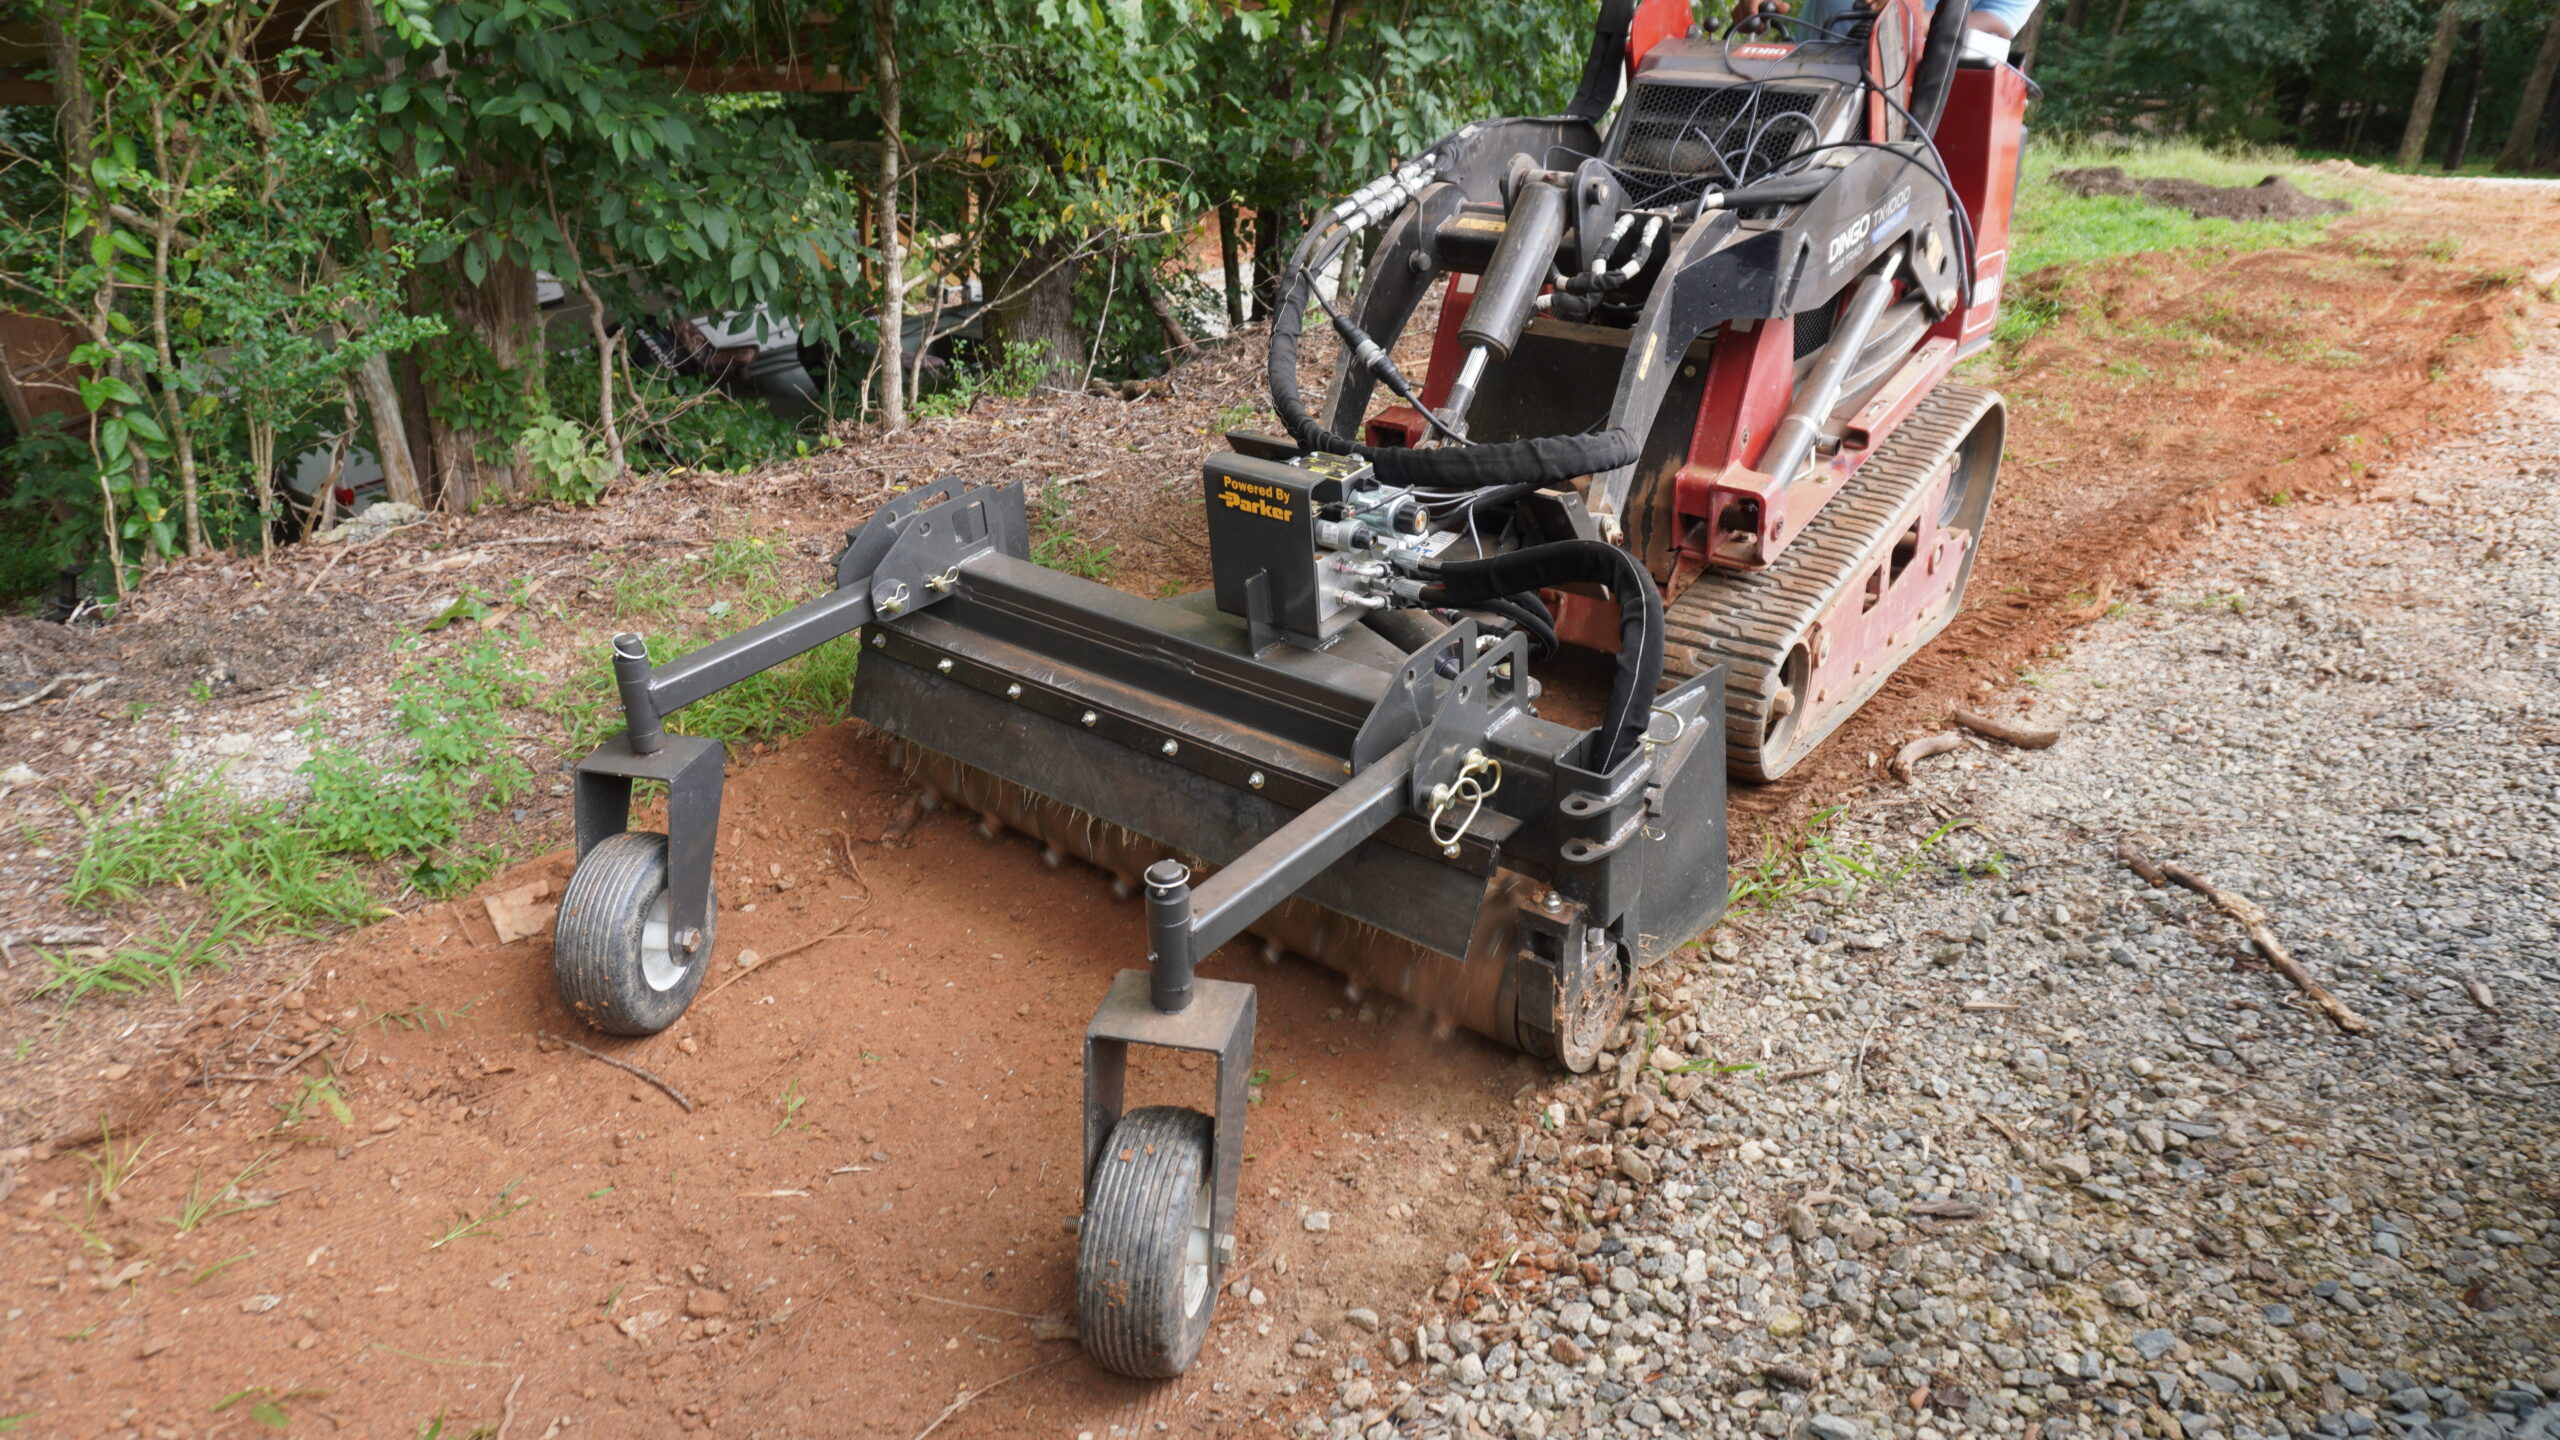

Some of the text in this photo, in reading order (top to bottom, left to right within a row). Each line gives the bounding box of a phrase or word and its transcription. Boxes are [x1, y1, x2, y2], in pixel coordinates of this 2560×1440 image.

[1743, 46, 1787, 55] TORO
[1828, 213, 1870, 264] DINGO
[1223, 475, 1290, 504] Powered By
[1218, 490, 1293, 522] Parker
